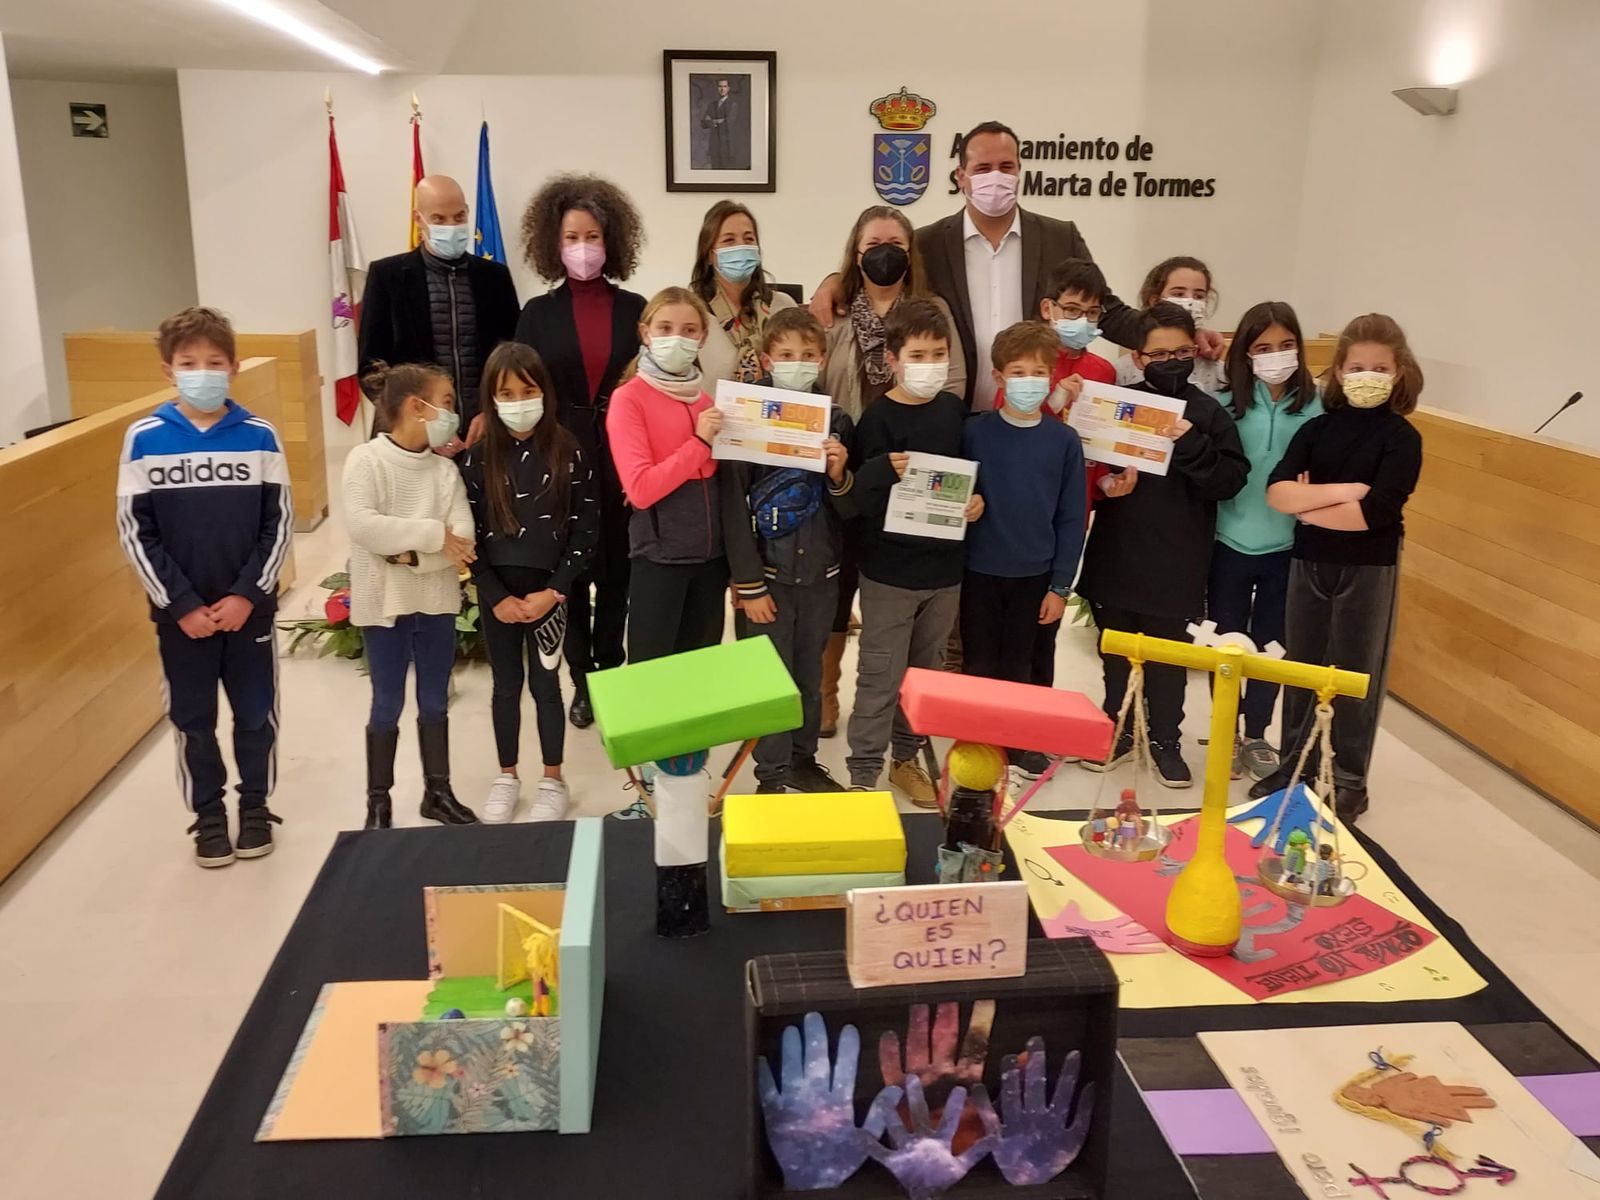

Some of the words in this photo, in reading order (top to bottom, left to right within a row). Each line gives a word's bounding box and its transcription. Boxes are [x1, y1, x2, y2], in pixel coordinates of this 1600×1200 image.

[950, 133, 1119, 161] Aamiento
[1125, 135, 1153, 161] de
[1022, 171, 1092, 197] Marta
[1099, 171, 1127, 197] de
[1134, 172, 1216, 197] Tormes
[148, 457, 250, 486] adidas
[534, 604, 567, 653] NIK
[876, 894, 983, 923] ¿QUIEN
[926, 922, 954, 942] ES
[1315, 922, 1373, 950] SEXO
[893, 938, 1006, 970] QUIEN?
[1317, 952, 1363, 976] NO
[1257, 963, 1321, 992] TIENE
